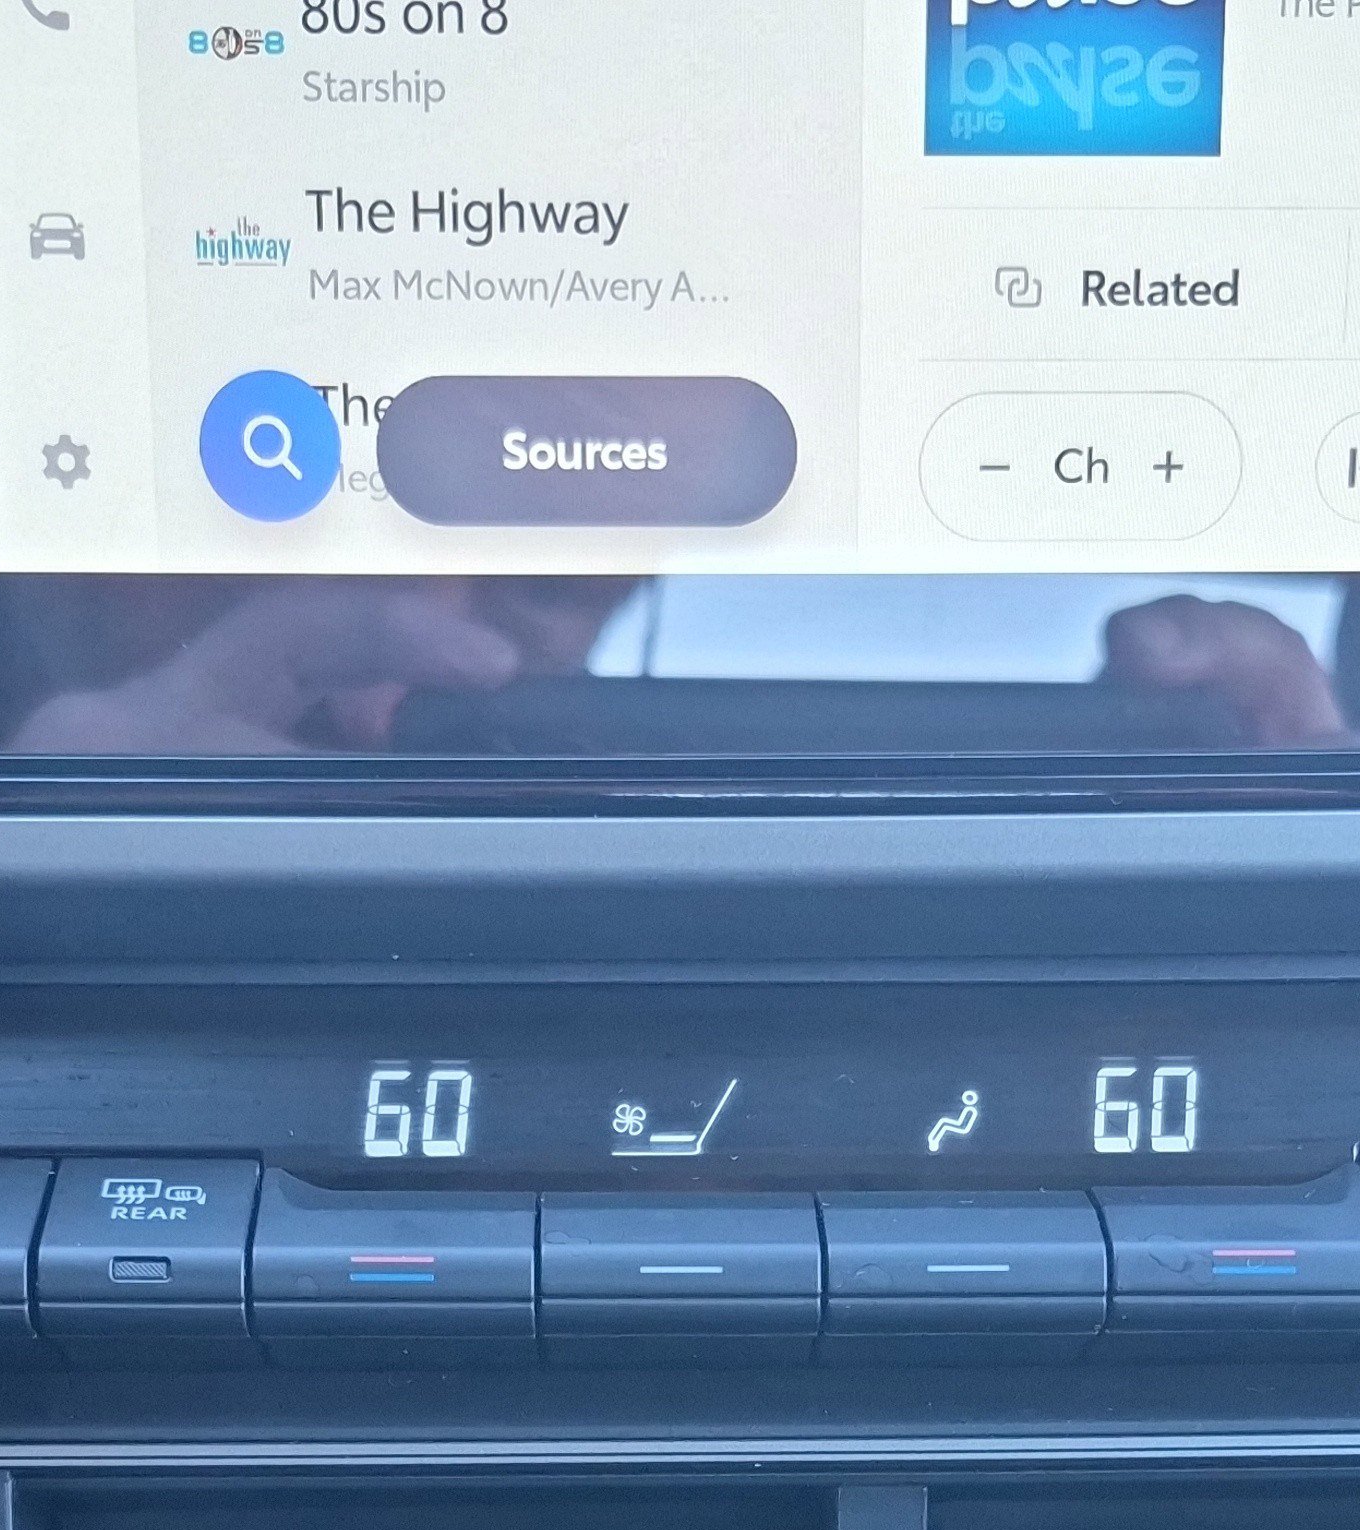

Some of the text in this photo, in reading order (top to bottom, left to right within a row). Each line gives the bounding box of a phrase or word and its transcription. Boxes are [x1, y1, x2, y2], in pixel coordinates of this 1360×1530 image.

[301, 0, 508, 35] 80s on 8
[302, 70, 446, 112] Starship
[237, 215, 261, 236] the
[305, 187, 630, 247] The Highway
[195, 229, 292, 267] highway
[309, 270, 382, 300] Max
[393, 269, 662, 311] McNown/Avery
[1081, 268, 1240, 307] Related
[501, 428, 668, 471] Sources
[1053, 446, 1110, 486] Ch
[362, 1068, 473, 1158] 60
[1093, 1065, 1199, 1154] 60
[110, 1204, 188, 1221] REAR
